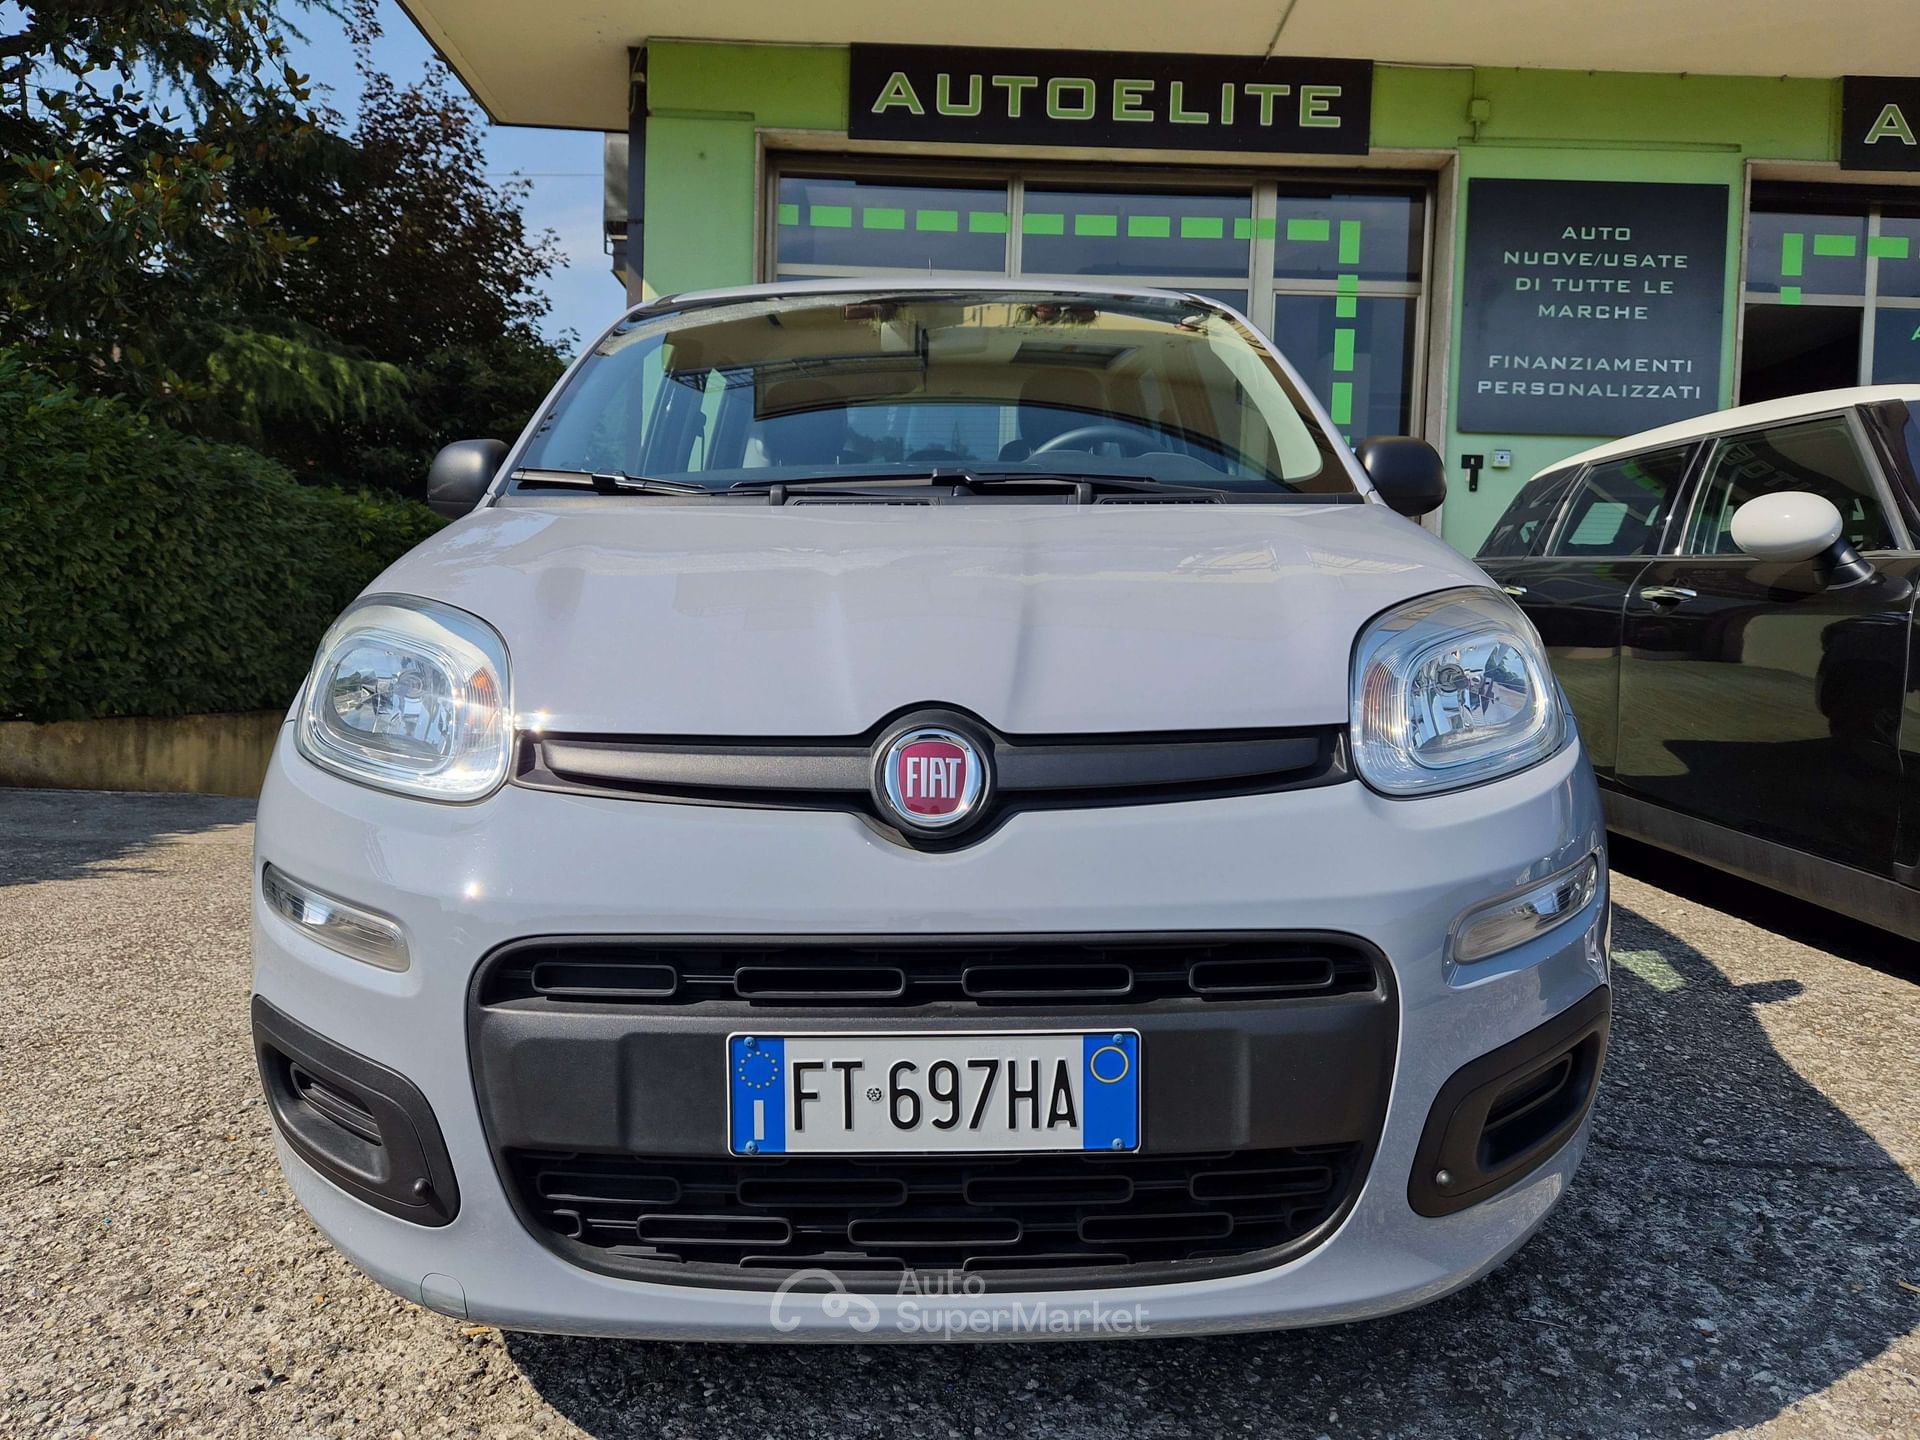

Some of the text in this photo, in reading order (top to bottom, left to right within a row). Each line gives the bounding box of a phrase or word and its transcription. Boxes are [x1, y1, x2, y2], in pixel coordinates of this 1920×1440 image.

[871, 71, 1342, 128] AUTOELITE
[1562, 227, 1631, 241] AUTO
[1503, 251, 1688, 268] NUOVE/USATE
[1515, 278, 1674, 294] DI TUTTE LE
[1537, 304, 1648, 319] MARCHE
[1488, 355, 1692, 373] FINANZIAMENTI
[1477, 381, 1701, 399] PERSONALIZZATI
[906, 757, 961, 799] FIAT
